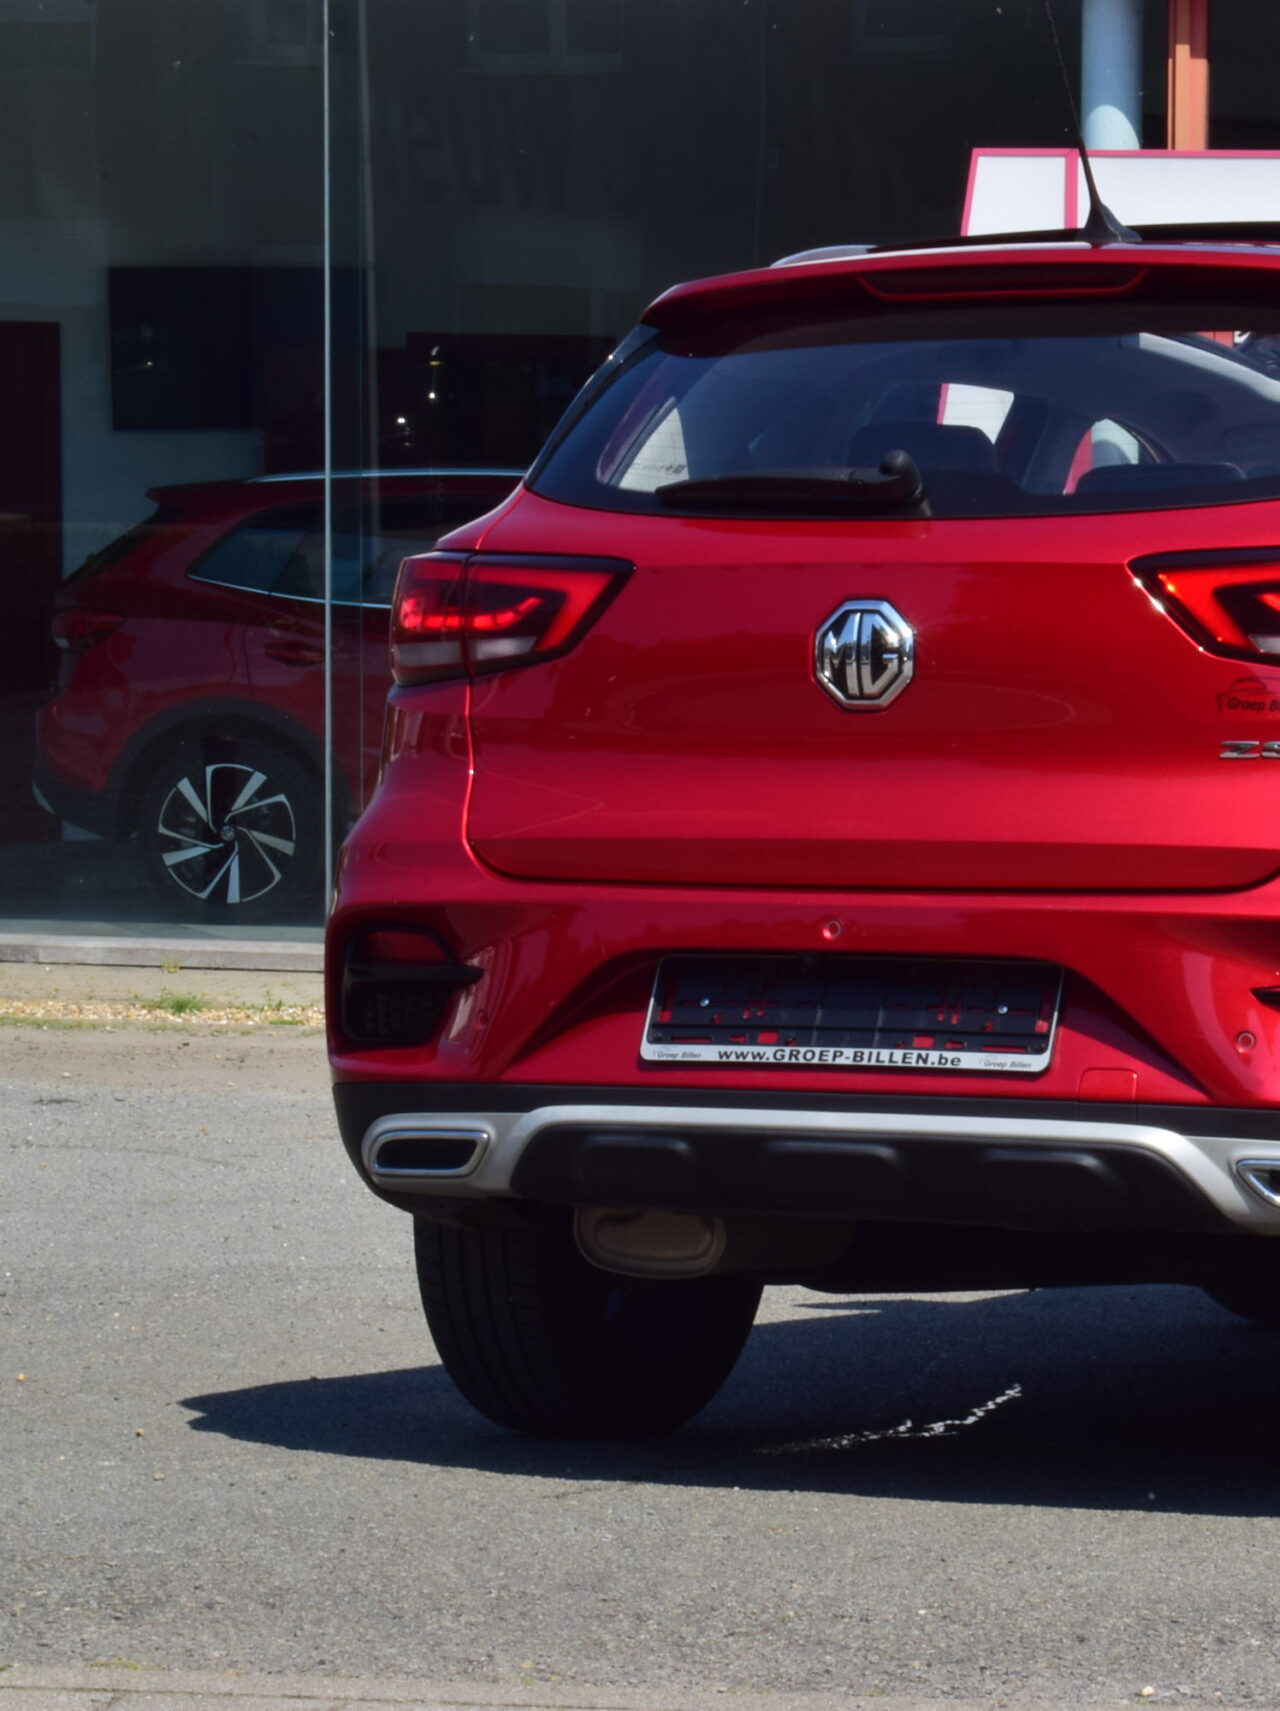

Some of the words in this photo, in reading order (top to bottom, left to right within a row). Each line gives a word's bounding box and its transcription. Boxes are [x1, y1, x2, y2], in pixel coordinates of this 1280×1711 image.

[821, 610, 900, 698] MG
[1226, 697, 1265, 713] Groep
[718, 1048, 962, 1067] www.GROEP-BILLEN.be
